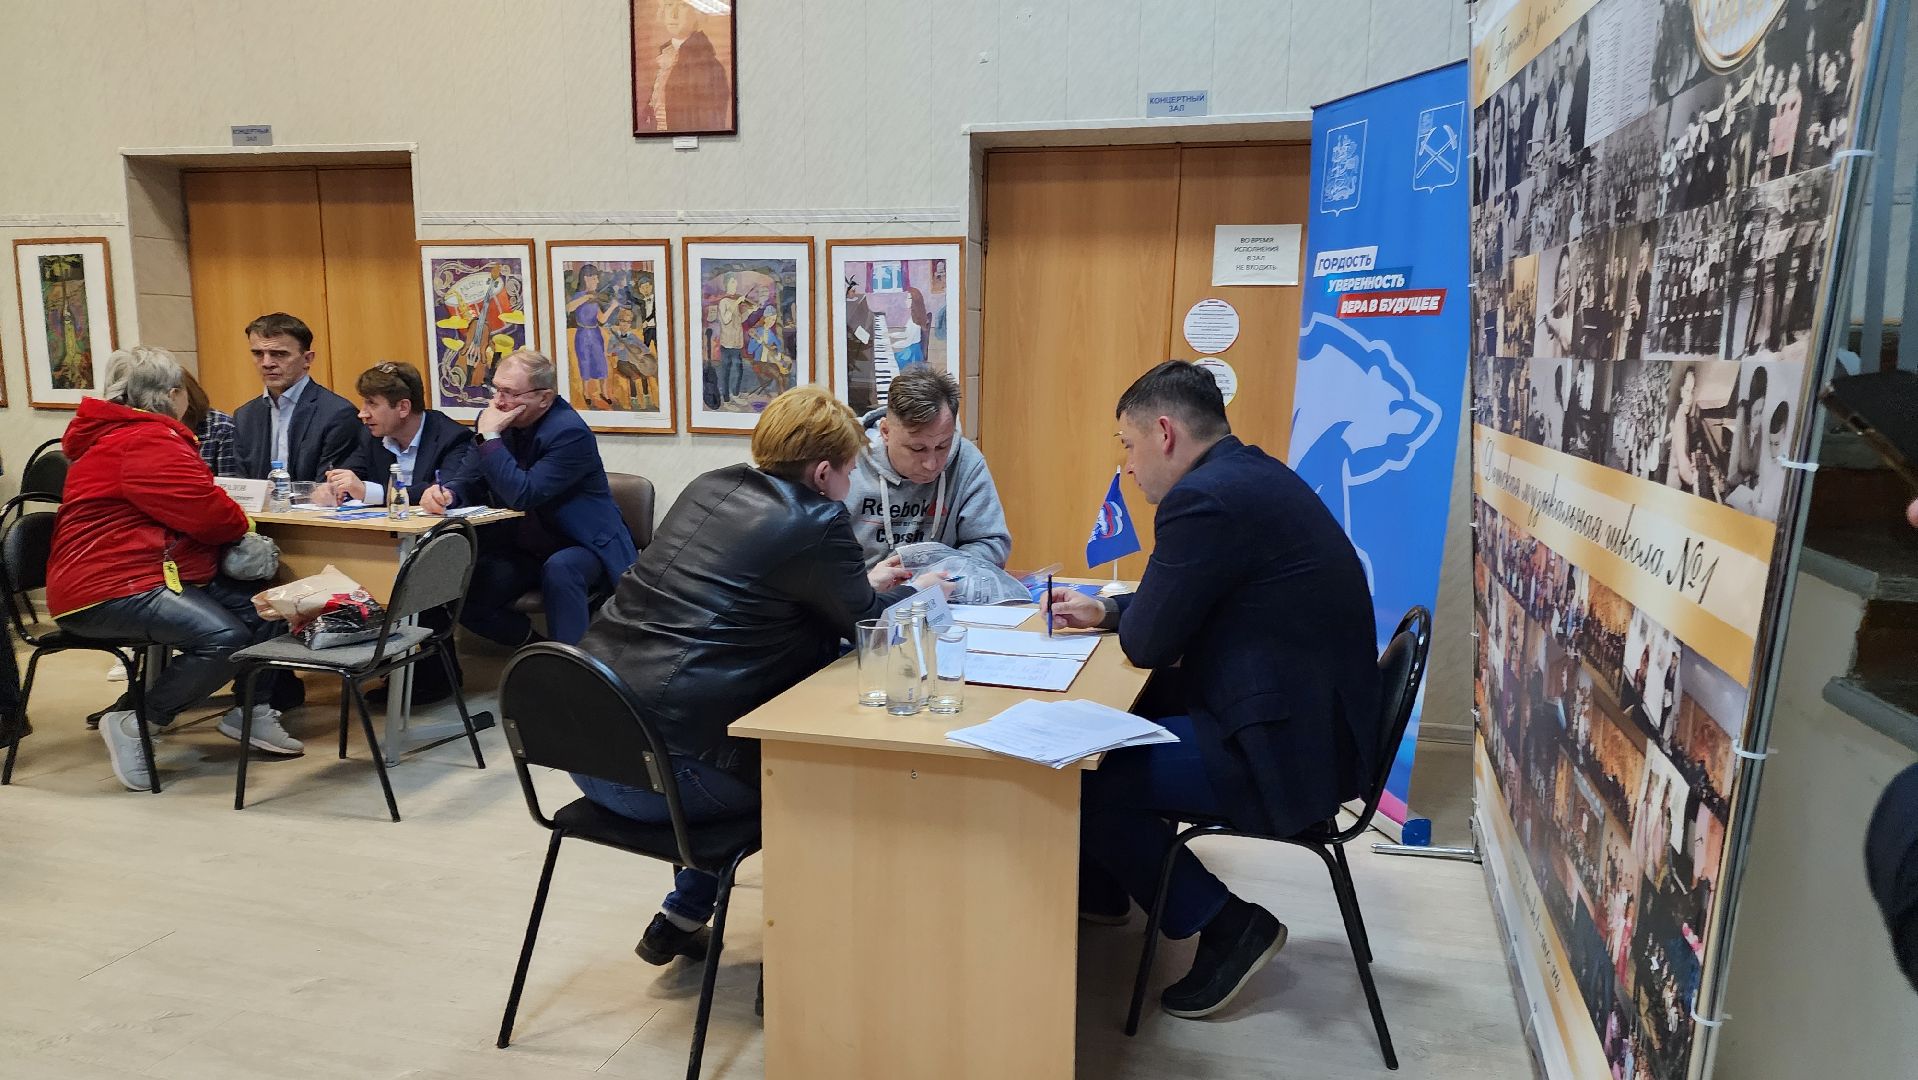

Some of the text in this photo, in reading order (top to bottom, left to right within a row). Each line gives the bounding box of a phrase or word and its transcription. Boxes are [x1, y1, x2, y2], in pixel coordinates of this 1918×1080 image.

[1149, 94, 1205, 104] КОНЦЕРТНЫЙ
[1168, 104, 1185, 112] ЗАЛ
[1318, 254, 1372, 271] ГОРДОСТЬ
[1327, 274, 1405, 292] УВЕРЕННОСТЬ
[1340, 296, 1441, 314] ВЕРА В БУДУЩЕЕ
[861, 497, 931, 518] Reebok
[1521, 473, 1603, 544] музыкальная
[1605, 503, 1664, 577] школа
[1667, 537, 1720, 604] №1
